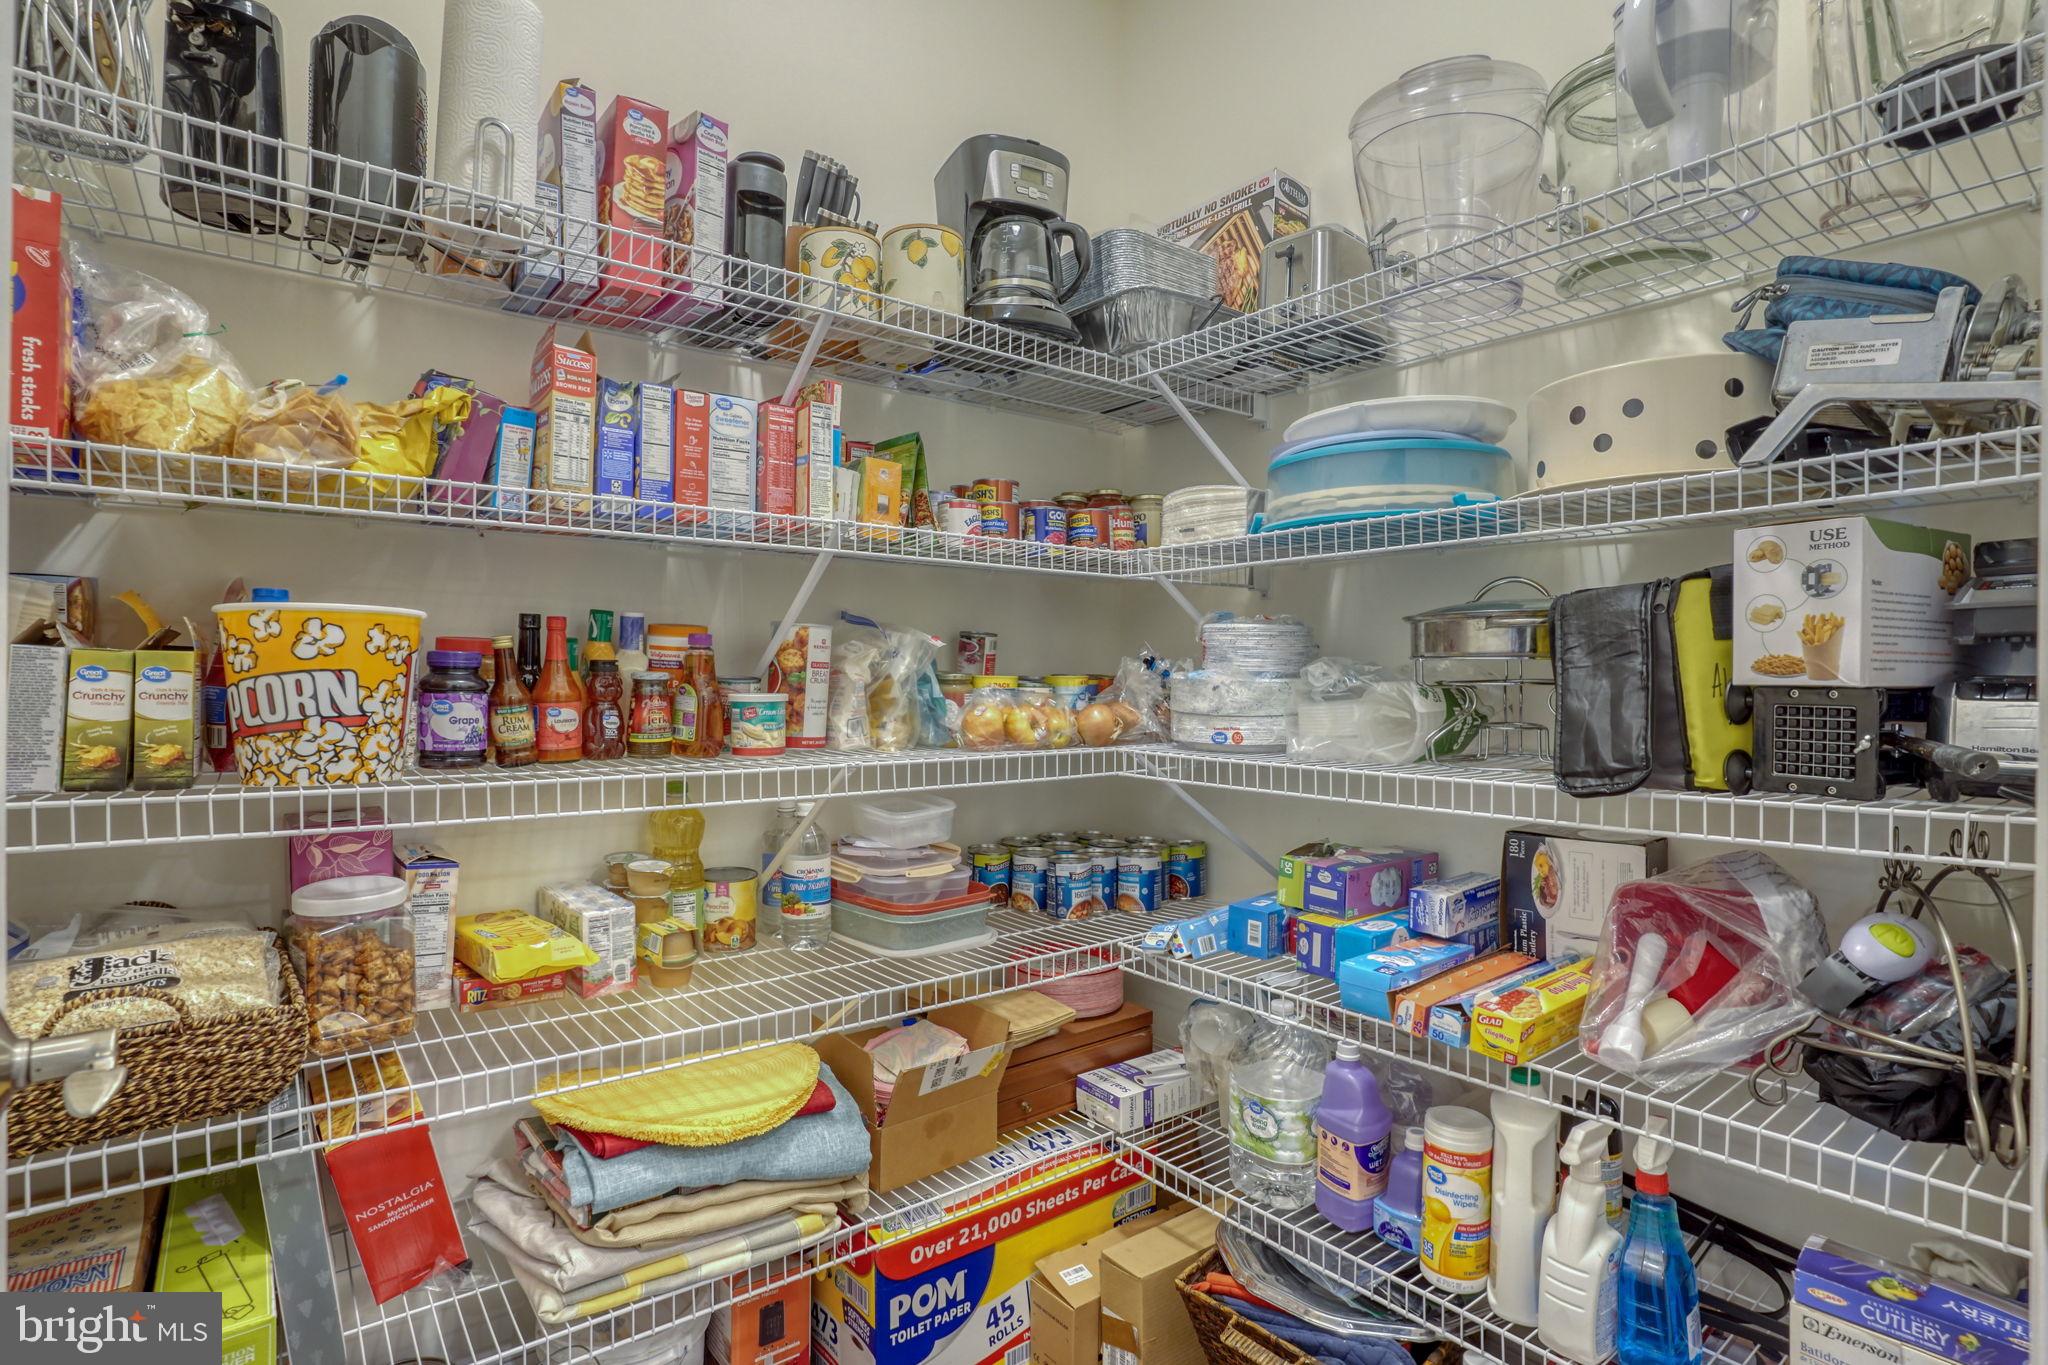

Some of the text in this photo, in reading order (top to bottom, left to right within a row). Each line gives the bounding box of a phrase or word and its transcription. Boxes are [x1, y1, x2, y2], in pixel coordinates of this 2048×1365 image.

[703, 129, 724, 141] Crunchy
[1204, 201, 1217, 216] NO
[1219, 182, 1258, 208] SMOKE!
[1188, 198, 1253, 232] SMOKE-LESS GRILL
[557, 354, 590, 370] Success
[21, 336, 42, 422] fresh stacks
[556, 381, 577, 390] BROWN
[716, 416, 750, 426] Sweetener
[1809, 526, 1848, 542] USE
[1808, 540, 1850, 552] METHOD
[72, 691, 126, 702] Crunchy
[138, 691, 188, 702] Crunchy
[227, 669, 368, 732] PCORN
[448, 716, 480, 726] Grape
[498, 724, 530, 734] CREAM
[502, 716, 526, 726] RUM
[1971, 744, 2020, 754] Hamilton
[1509, 838, 1520, 858] 180
[1074, 890, 1084, 899] 160
[1520, 912, 1528, 937] Plastic
[1528, 930, 1538, 959] Cutlery
[70, 948, 174, 988] Jack
[100, 968, 174, 984] Beanstalk
[133, 964, 156, 973] the
[468, 990, 488, 1004] RITZ
[1414, 1020, 1424, 1034] 25
[1478, 1015, 1504, 1027] GLAD
[1432, 1029, 1444, 1041] 50
[1484, 1028, 1516, 1045] ClingWrap
[1521, 1024, 1536, 1041] GLAD
[988, 1150, 1015, 1170] 45
[1028, 1128, 1073, 1152] 473
[1440, 1152, 1452, 1160] KILLS
[1368, 1158, 1383, 1169] WET
[1434, 1154, 1457, 1166] BACTERIA
[355, 1180, 434, 1222] NOSTALGIA
[1434, 1186, 1479, 1201] Disinfecting
[387, 1202, 414, 1218] MyMini
[1453, 1196, 1476, 1208] Wipes
[368, 1198, 434, 1234] SANDWICH MAKER
[910, 1160, 1143, 1264] Over 21,000 Sheets Per Case
[1424, 1240, 1433, 1254] 35
[889, 1270, 965, 1330] POM
[847, 1306, 870, 1336] SOFTNESS
[986, 1295, 1016, 1331] 45
[812, 1301, 838, 1345] 473
[848, 1314, 870, 1344] STRENGTH
[890, 1302, 972, 1346] TOILET PAPER
[988, 1314, 1024, 1348] ROLLS
[1860, 1304, 1951, 1346] CUTLERY
[1822, 1322, 1901, 1364] Emerson
[1800, 1341, 1849, 1365] Batidor
